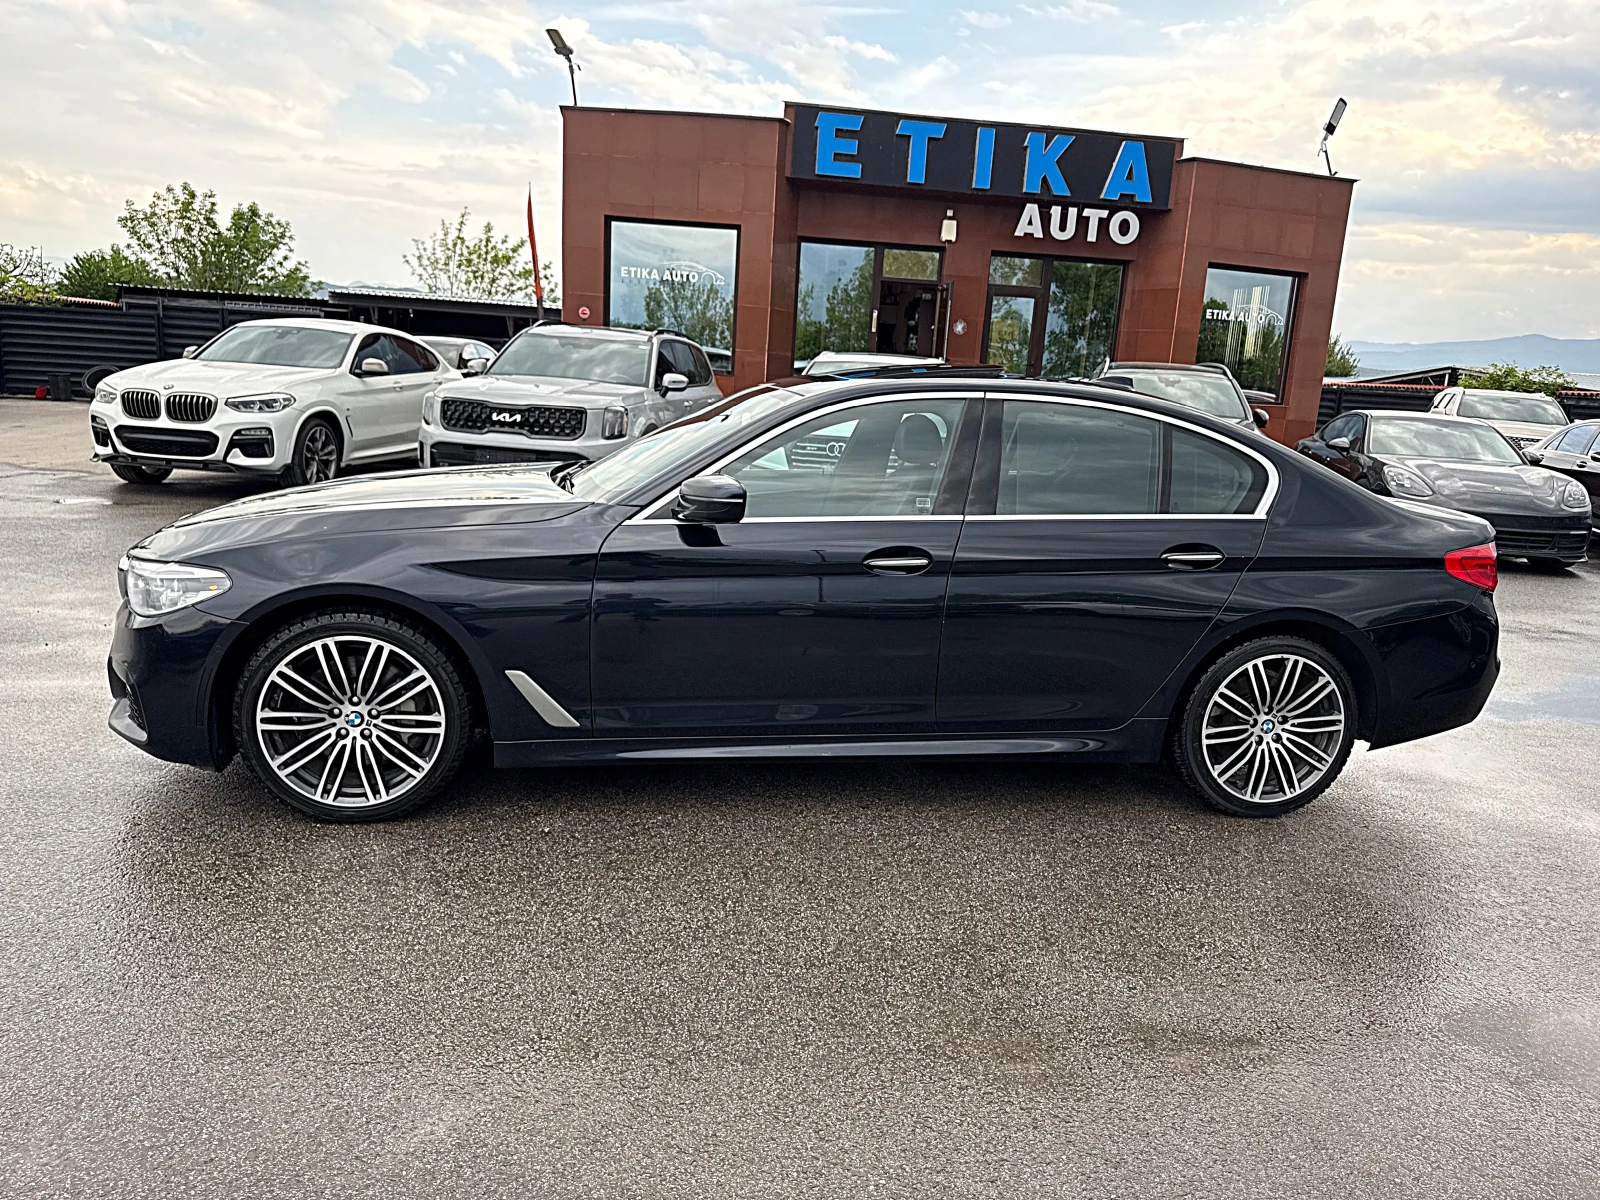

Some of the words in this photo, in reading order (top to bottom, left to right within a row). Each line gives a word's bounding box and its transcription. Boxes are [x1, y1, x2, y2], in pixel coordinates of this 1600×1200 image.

[814, 111, 1153, 203] ETIKA
[1014, 203, 1140, 245] AUTO
[621, 267, 659, 280] ETIKA
[663, 270, 699, 282] AUTO
[1205, 309, 1235, 321] ETIKA
